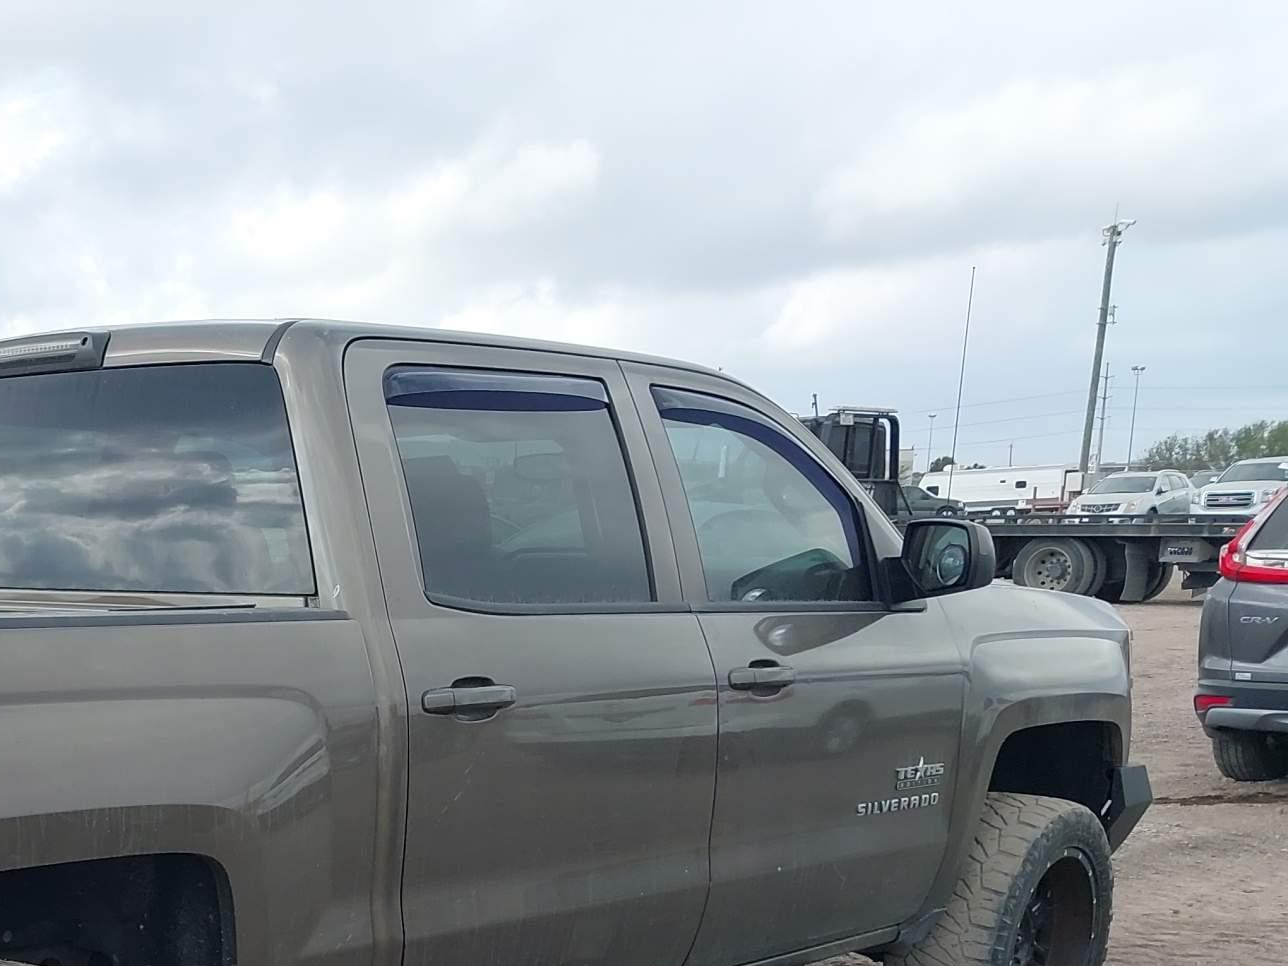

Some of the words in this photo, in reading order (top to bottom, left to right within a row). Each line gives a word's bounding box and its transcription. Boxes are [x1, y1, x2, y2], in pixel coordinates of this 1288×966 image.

[1240, 616, 1279, 625] CR-V
[895, 756, 945, 780] TEXAS
[856, 792, 939, 816] SILVERADO
